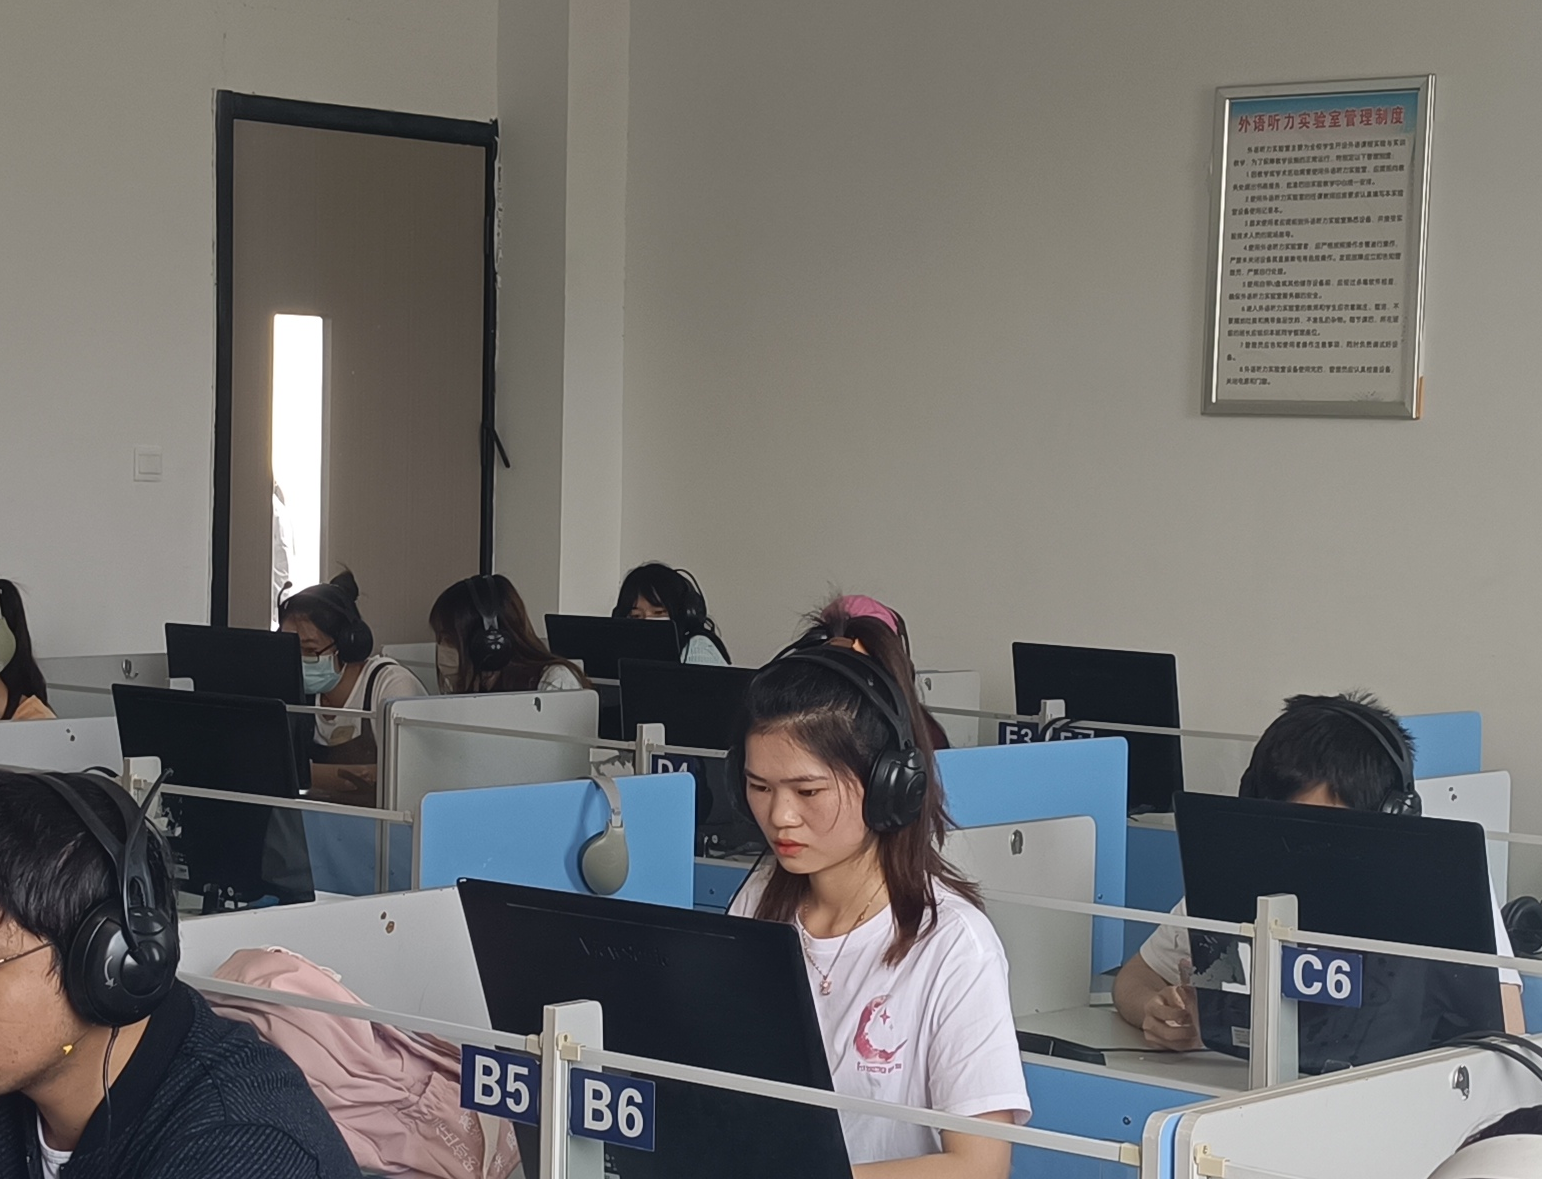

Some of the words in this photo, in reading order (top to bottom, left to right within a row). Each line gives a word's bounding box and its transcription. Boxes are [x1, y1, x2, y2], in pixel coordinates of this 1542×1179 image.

[1238, 106, 1404, 133] 外语听力实验室管理制度
[1293, 953, 1352, 999] C6
[474, 1055, 530, 1113] B5
[584, 1078, 644, 1138] B6
